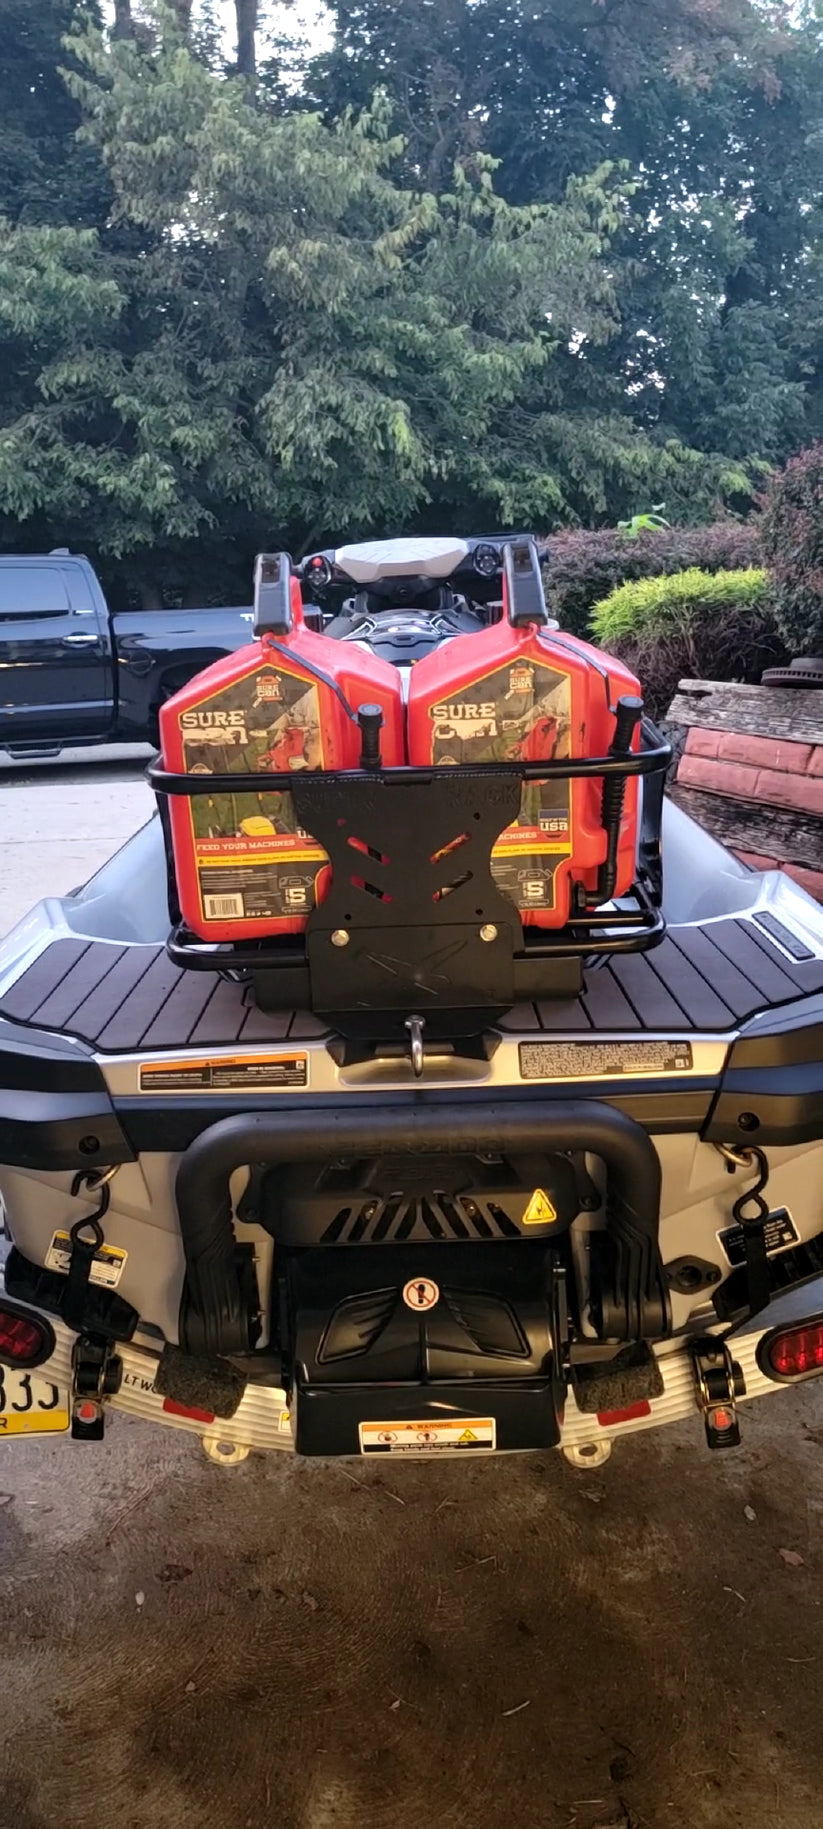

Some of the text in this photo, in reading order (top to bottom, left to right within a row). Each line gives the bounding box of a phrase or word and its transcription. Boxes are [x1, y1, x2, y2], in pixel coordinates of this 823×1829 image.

[182, 709, 245, 728] SURE
[432, 702, 496, 720] SURE
[499, 831, 538, 841] ACHINES
[196, 839, 296, 851] FEED YOUR MACHINES
